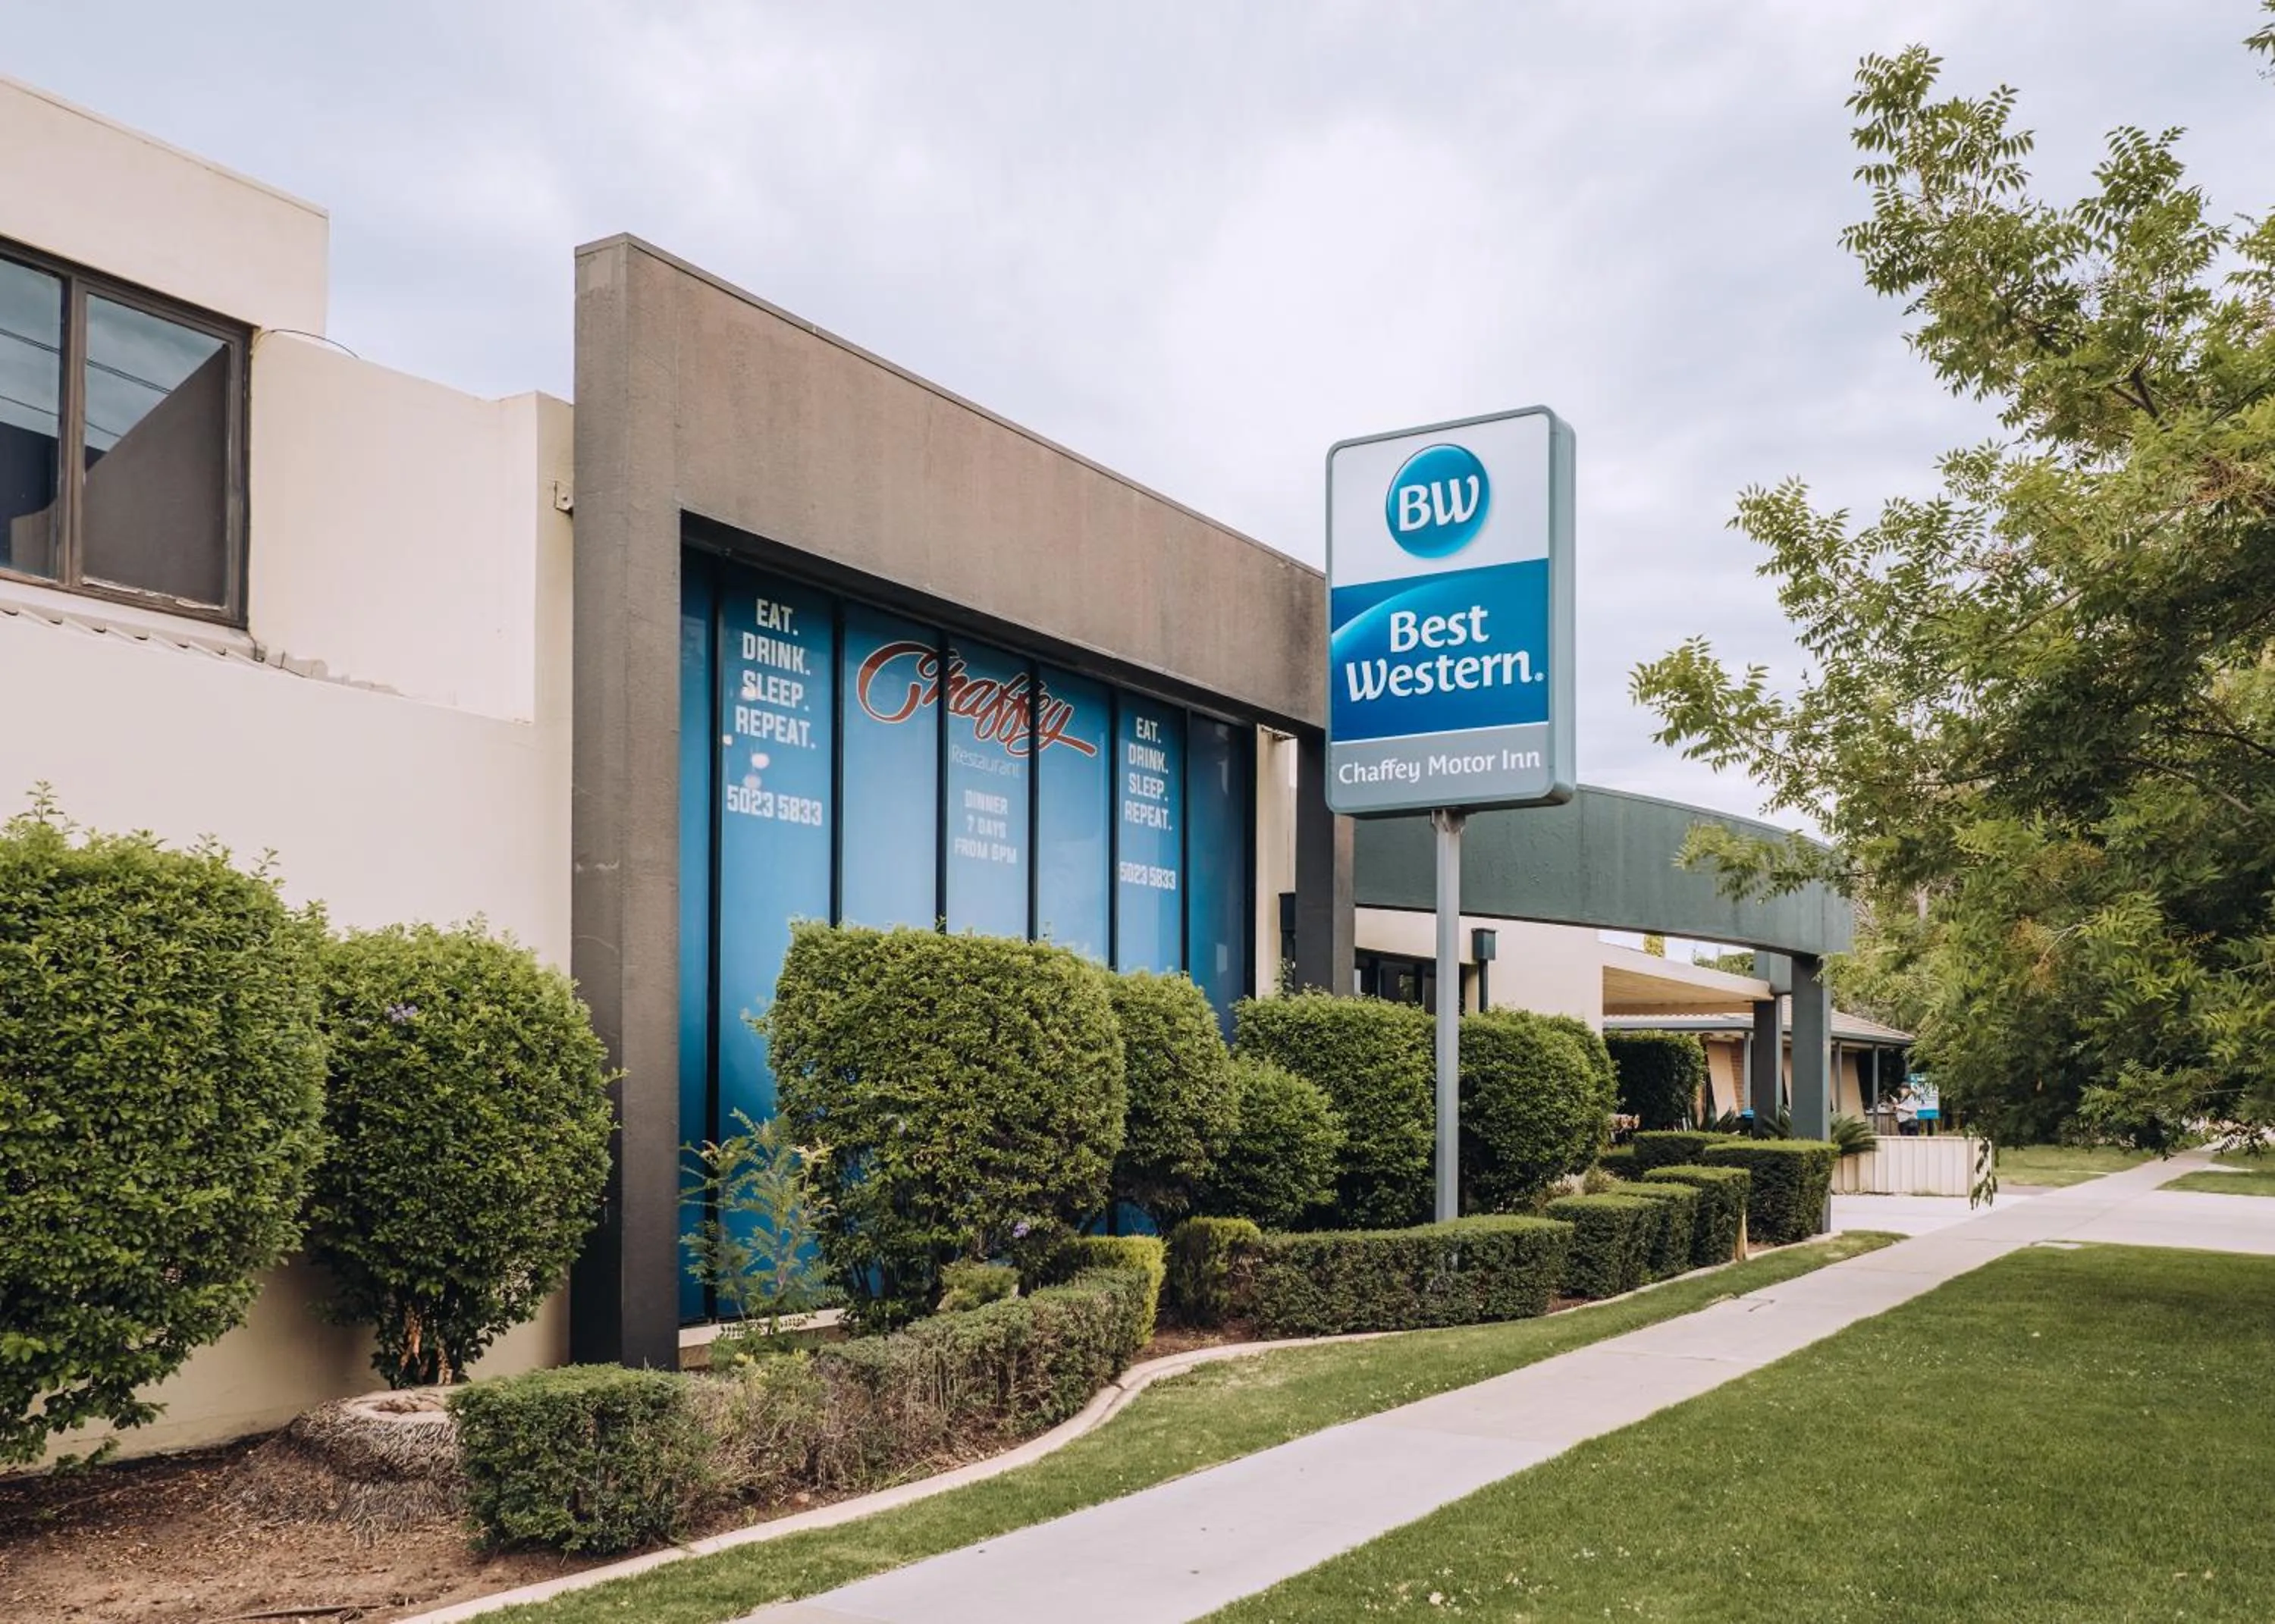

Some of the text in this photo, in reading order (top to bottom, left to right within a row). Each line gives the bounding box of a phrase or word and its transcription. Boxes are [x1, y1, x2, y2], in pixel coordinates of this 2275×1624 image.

[1398, 474, 1480, 532] BW
[756, 598, 799, 635] EAT.
[1389, 604, 1489, 654] Best
[742, 632, 811, 676] DRINK.
[741, 669, 810, 712] SLEEP.
[735, 705, 816, 749] REPEAT.
[1135, 716, 1161, 744] EAT.
[951, 745, 1020, 779] Restaurant
[1128, 743, 1169, 774] DRINK.
[1338, 749, 1540, 784] Chaffey Motor Inn
[964, 788, 1008, 815] DINNER
[1128, 772, 1168, 801] SLEEP.
[726, 784, 823, 826] 5023 5833
[1125, 800, 1172, 831] REPEAT.
[977, 817, 1006, 839] DAYS
[954, 837, 987, 861] FROM
[1119, 861, 1176, 890] 5023 5833
